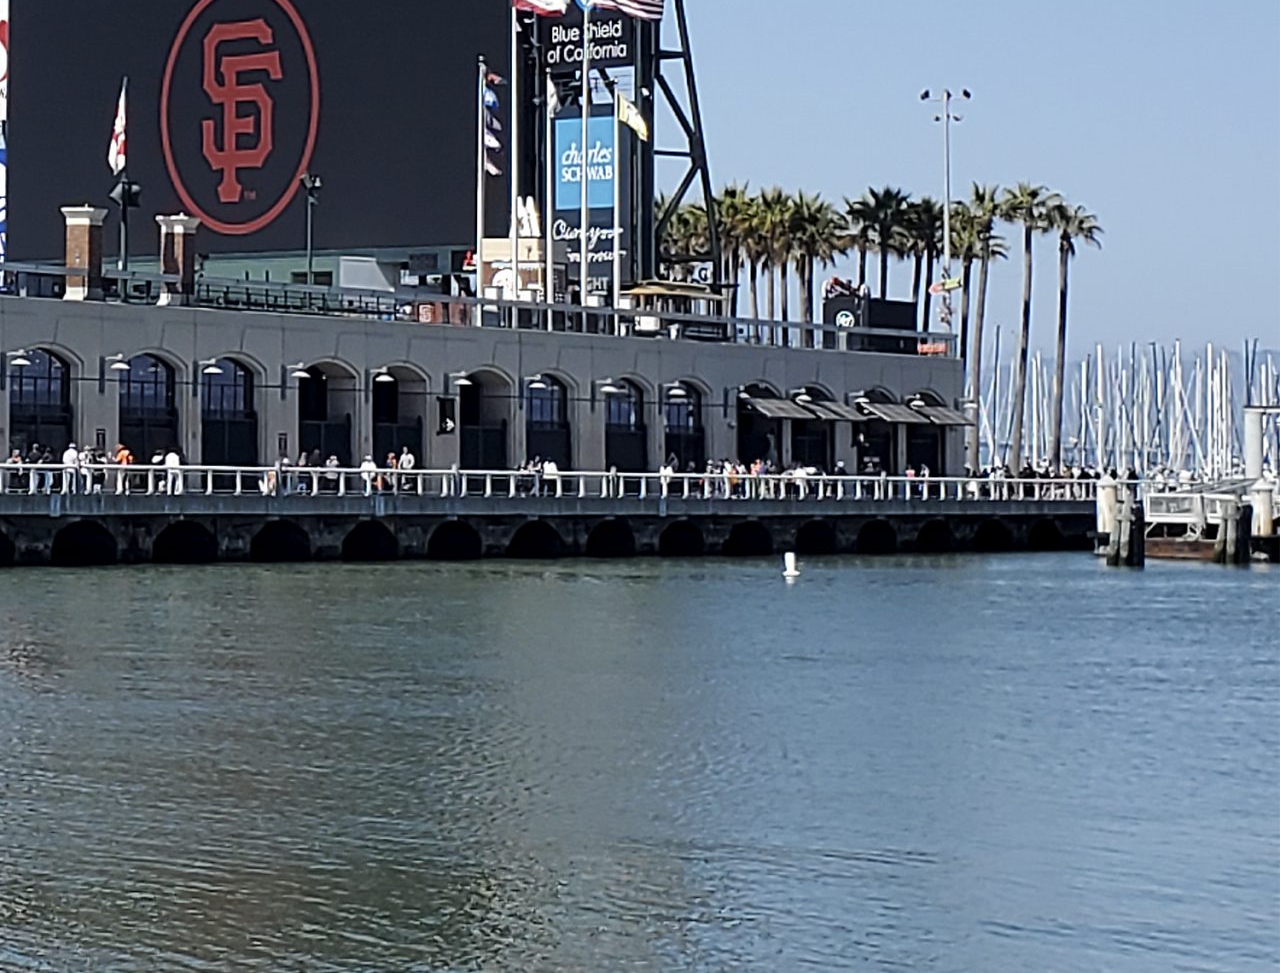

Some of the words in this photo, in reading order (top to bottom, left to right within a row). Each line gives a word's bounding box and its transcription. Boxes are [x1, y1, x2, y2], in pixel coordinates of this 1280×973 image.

[552, 25, 580, 44] Blue
[583, 20, 622, 40] hield
[547, 46, 560, 64] of
[563, 40, 627, 63] Caifornia
